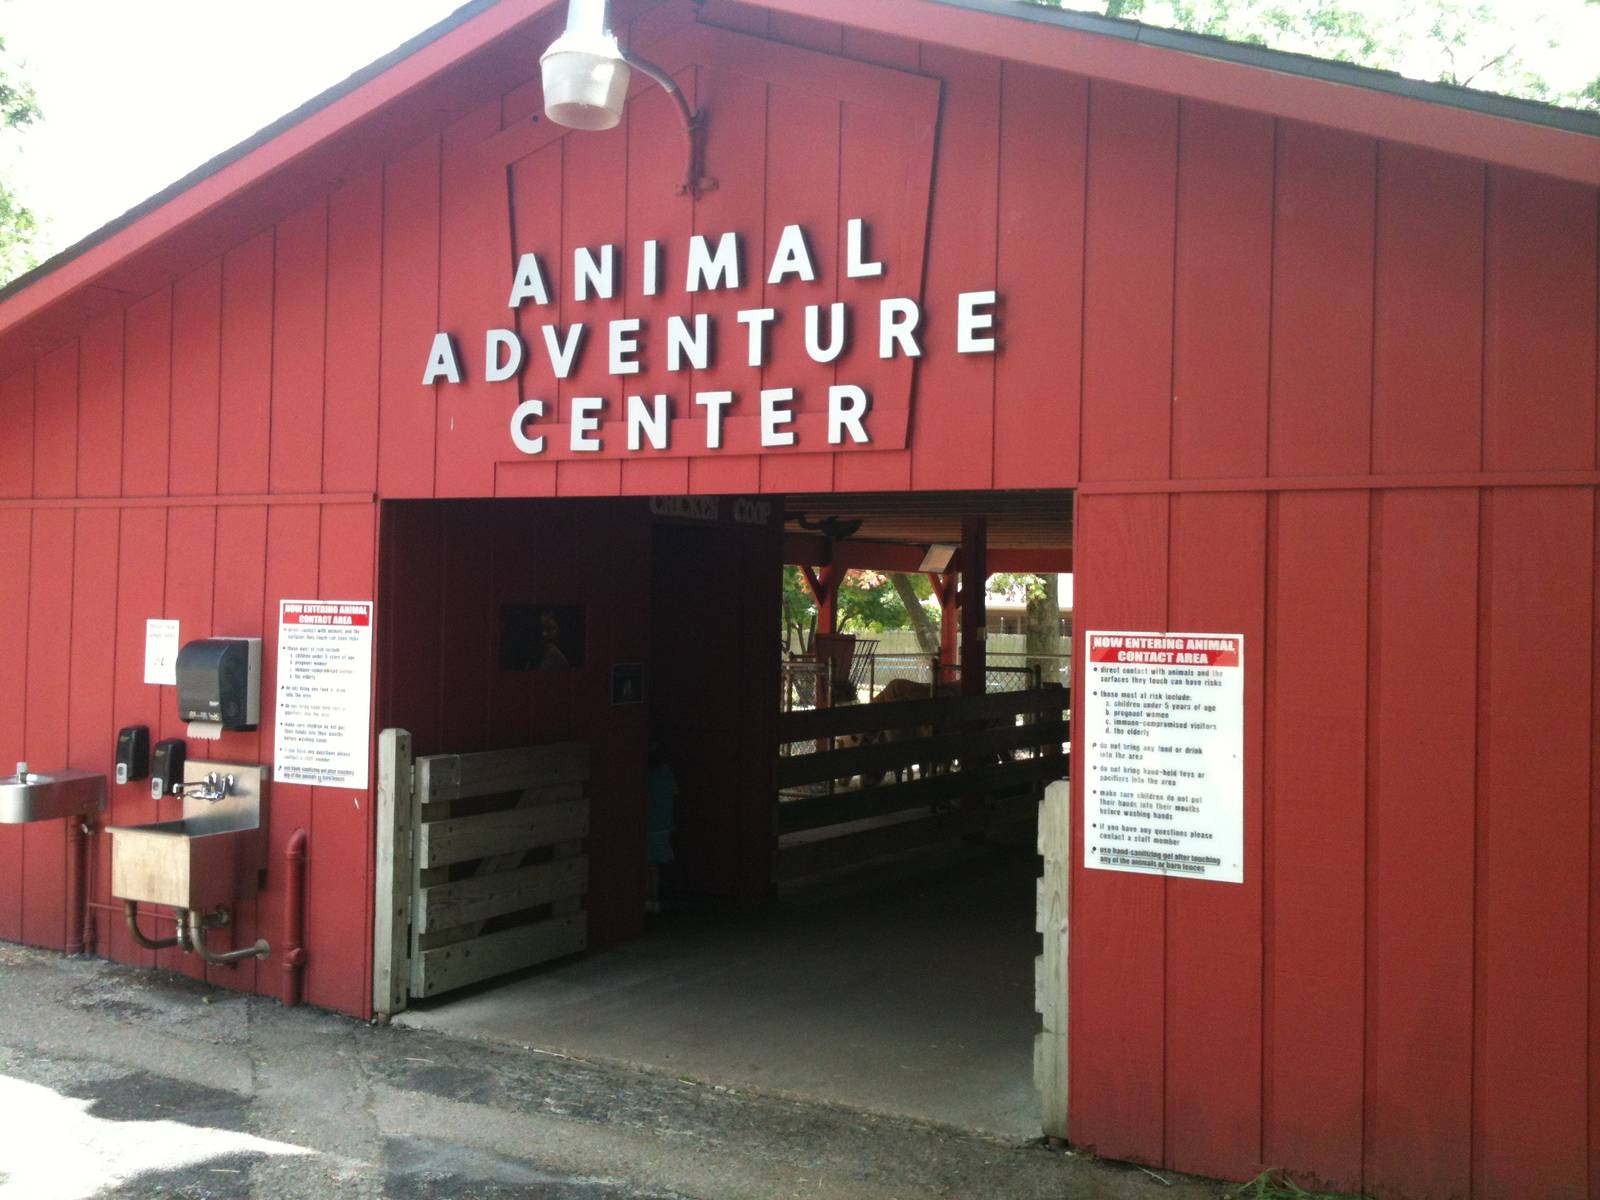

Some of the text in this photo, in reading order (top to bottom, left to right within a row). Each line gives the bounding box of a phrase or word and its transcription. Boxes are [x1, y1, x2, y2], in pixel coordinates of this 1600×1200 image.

[507, 218, 885, 308] ANIMAL
[422, 290, 997, 386] ADVENTURE
[509, 384, 870, 454] CENTER
[1094, 636, 1235, 651] NOW ENTERING ANIMAL
[1117, 651, 1208, 664] CONTACT AREA
